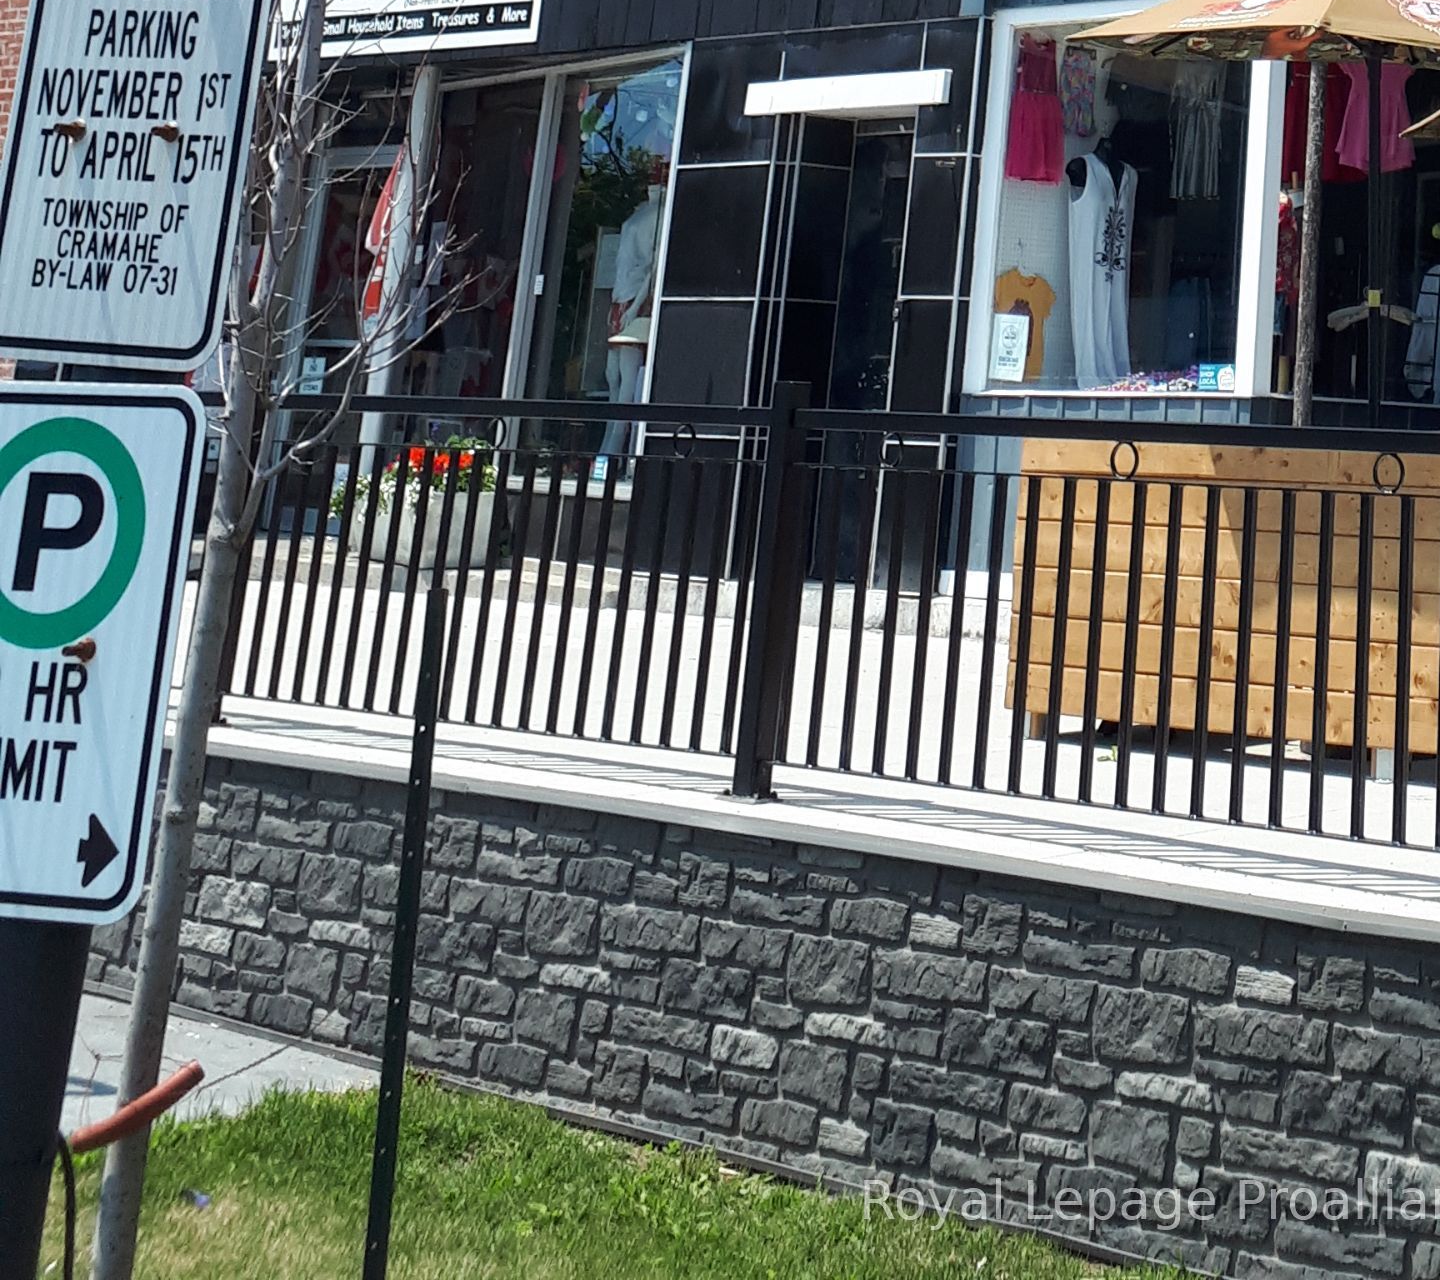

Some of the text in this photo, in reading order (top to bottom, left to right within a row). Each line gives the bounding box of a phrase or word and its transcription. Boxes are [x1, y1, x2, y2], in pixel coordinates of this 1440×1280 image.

[84, 8, 200, 60] PARKING
[395, 14, 425, 32] Items
[431, 11, 480, 28] Treasures
[485, 6, 495, 24] &
[501, 5, 528, 23] More
[36, 68, 232, 122] NOVEMBER 1ST
[38, 128, 227, 185] TO APRIL 15TH
[43, 198, 190, 234] TOWNSHIP OF
[57, 229, 163, 264] CRAMAHE
[31, 258, 179, 296] BY-LAW 07-31
[11, 471, 104, 592] P
[24, 660, 89, 725] HR
[0, 737, 78, 804] MIT
